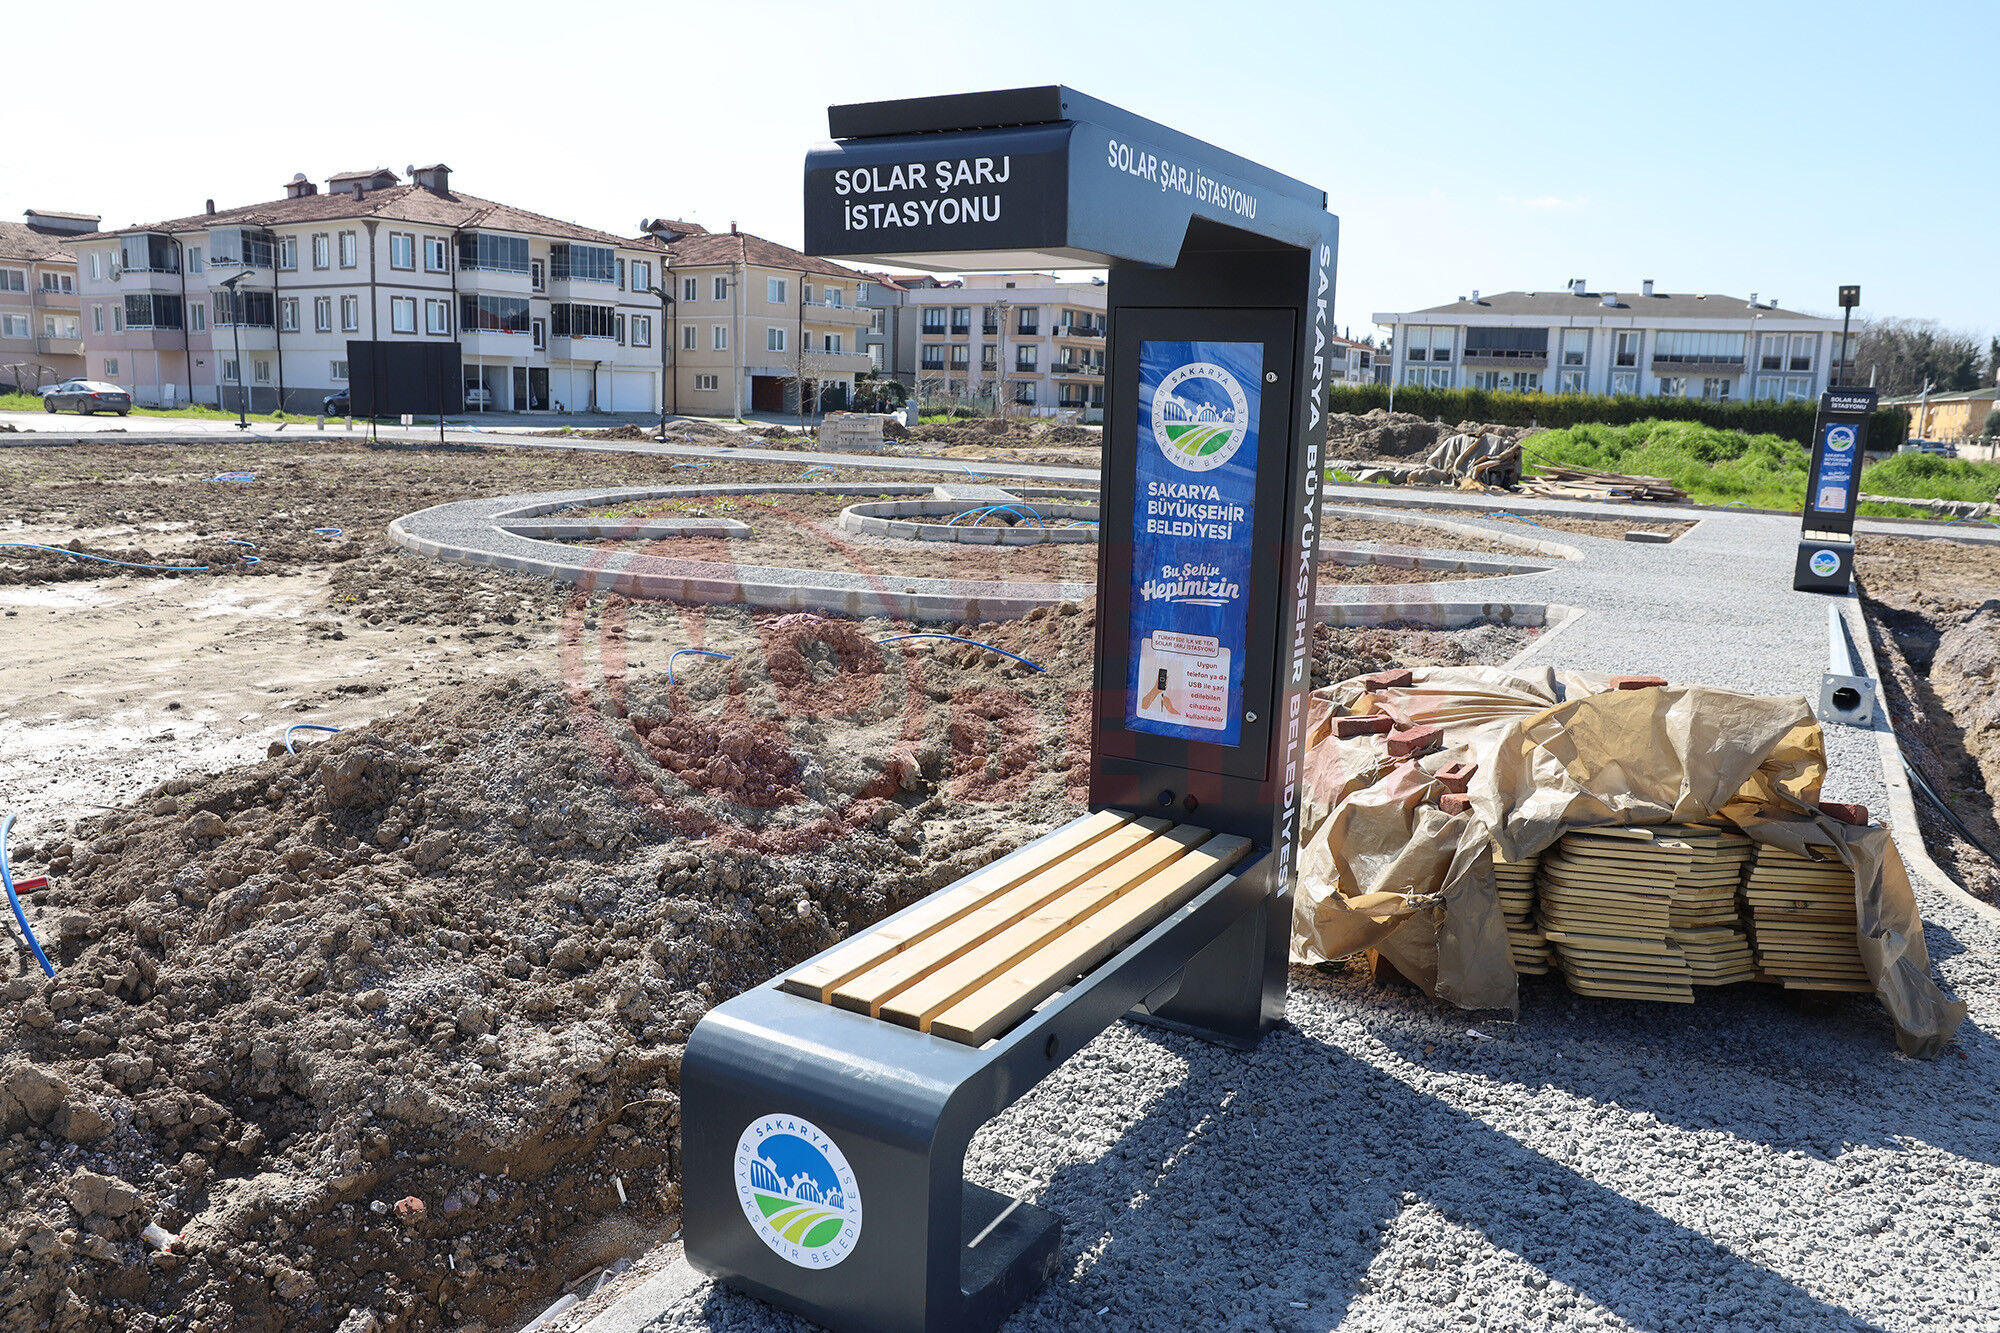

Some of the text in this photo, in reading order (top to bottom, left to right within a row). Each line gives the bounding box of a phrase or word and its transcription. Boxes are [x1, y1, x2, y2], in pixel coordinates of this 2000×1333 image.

[835, 156, 1010, 195] SOLAR ŞARJ
[1108, 139, 1257, 220] SOLAR ŞARJ İSTASYONU
[845, 195, 1001, 231] İSTASYONU
[1171, 366, 1229, 385] SAKARYA
[1147, 481, 1221, 501] SAKARYA
[1147, 498, 1245, 523] BÜYÜKŞEHİR
[1147, 519, 1233, 540] BELEDİYESİ
[1161, 563, 1220, 581] Bu Şehir
[1277, 242, 1331, 899] SAKARYA BÜYÜKŞEHİR BELEDİYESİ
[1140, 577, 1240, 602] Hepimizin
[1197, 661, 1218, 670] Uygun
[1187, 671, 1209, 679] telefon
[1217, 673, 1227, 681] da
[1188, 681, 1202, 689] USB
[1190, 692, 1221, 702] edilebilen
[1189, 703, 1221, 713] cihazlarda
[755, 1120, 830, 1153] SAKARYA
